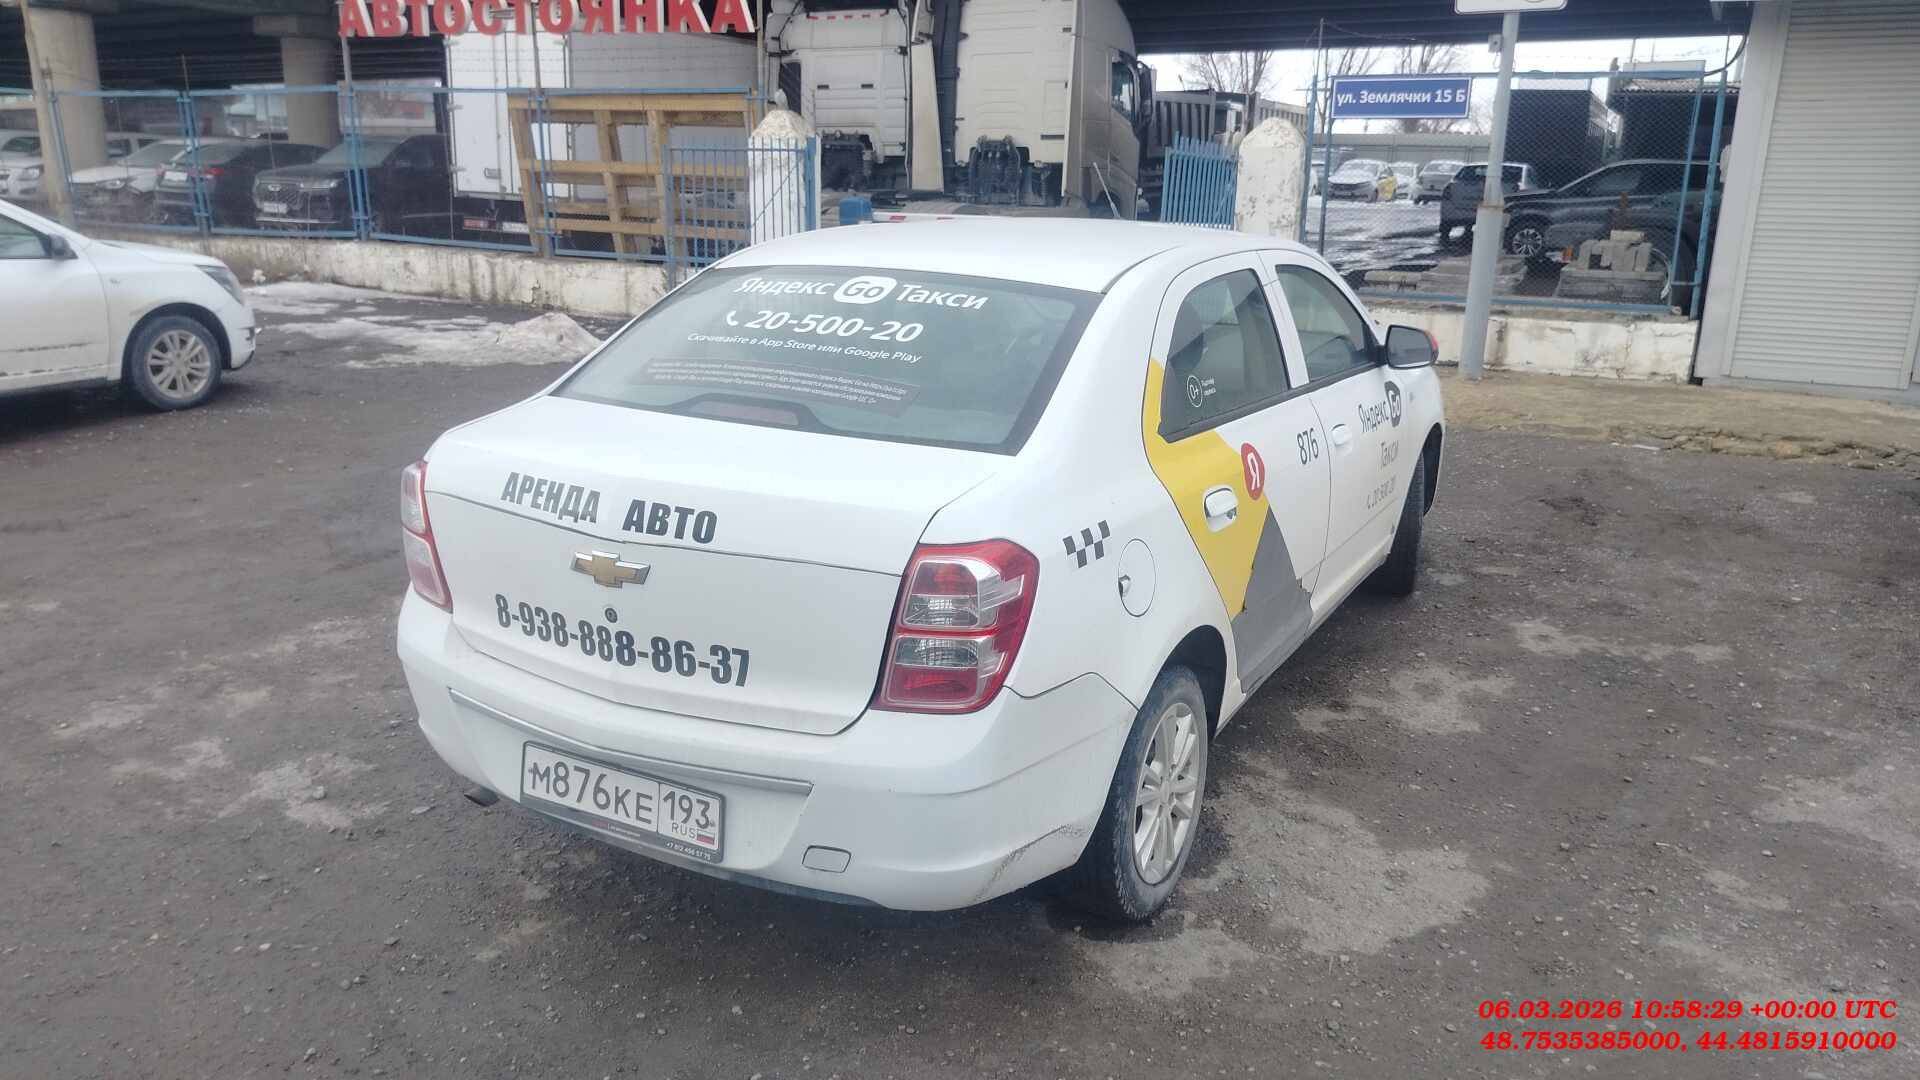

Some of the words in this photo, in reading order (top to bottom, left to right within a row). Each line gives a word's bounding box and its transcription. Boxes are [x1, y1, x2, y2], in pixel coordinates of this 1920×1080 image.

[338, 0, 757, 36] АВТОСТОЯНКА
[1337, 93, 1356, 107] ул.
[1360, 90, 1431, 104] Землячки
[1434, 89, 1452, 103] 15
[1455, 89, 1466, 103] Б
[732, 276, 836, 297] Яндекс
[839, 280, 887, 299] Go
[896, 283, 989, 310] Такси
[743, 310, 925, 343] 20-500-20
[687, 333, 751, 346] Скачивайте
[758, 337, 784, 349] App
[786, 339, 817, 352] Store
[817, 343, 843, 354] или
[843, 346, 891, 361] Google
[892, 350, 923, 365] Play
[1357, 400, 1390, 434] Яндекс
[1296, 427, 1319, 465] 876
[1246, 451, 1260, 491] Я
[500, 471, 601, 524] АРЕНДА
[621, 498, 718, 545] АВТО
[495, 593, 751, 688] 8-938-888-86-37
[531, 761, 653, 825] М876КЕ
[663, 790, 711, 830] 193
[671, 822, 697, 840] RUS
